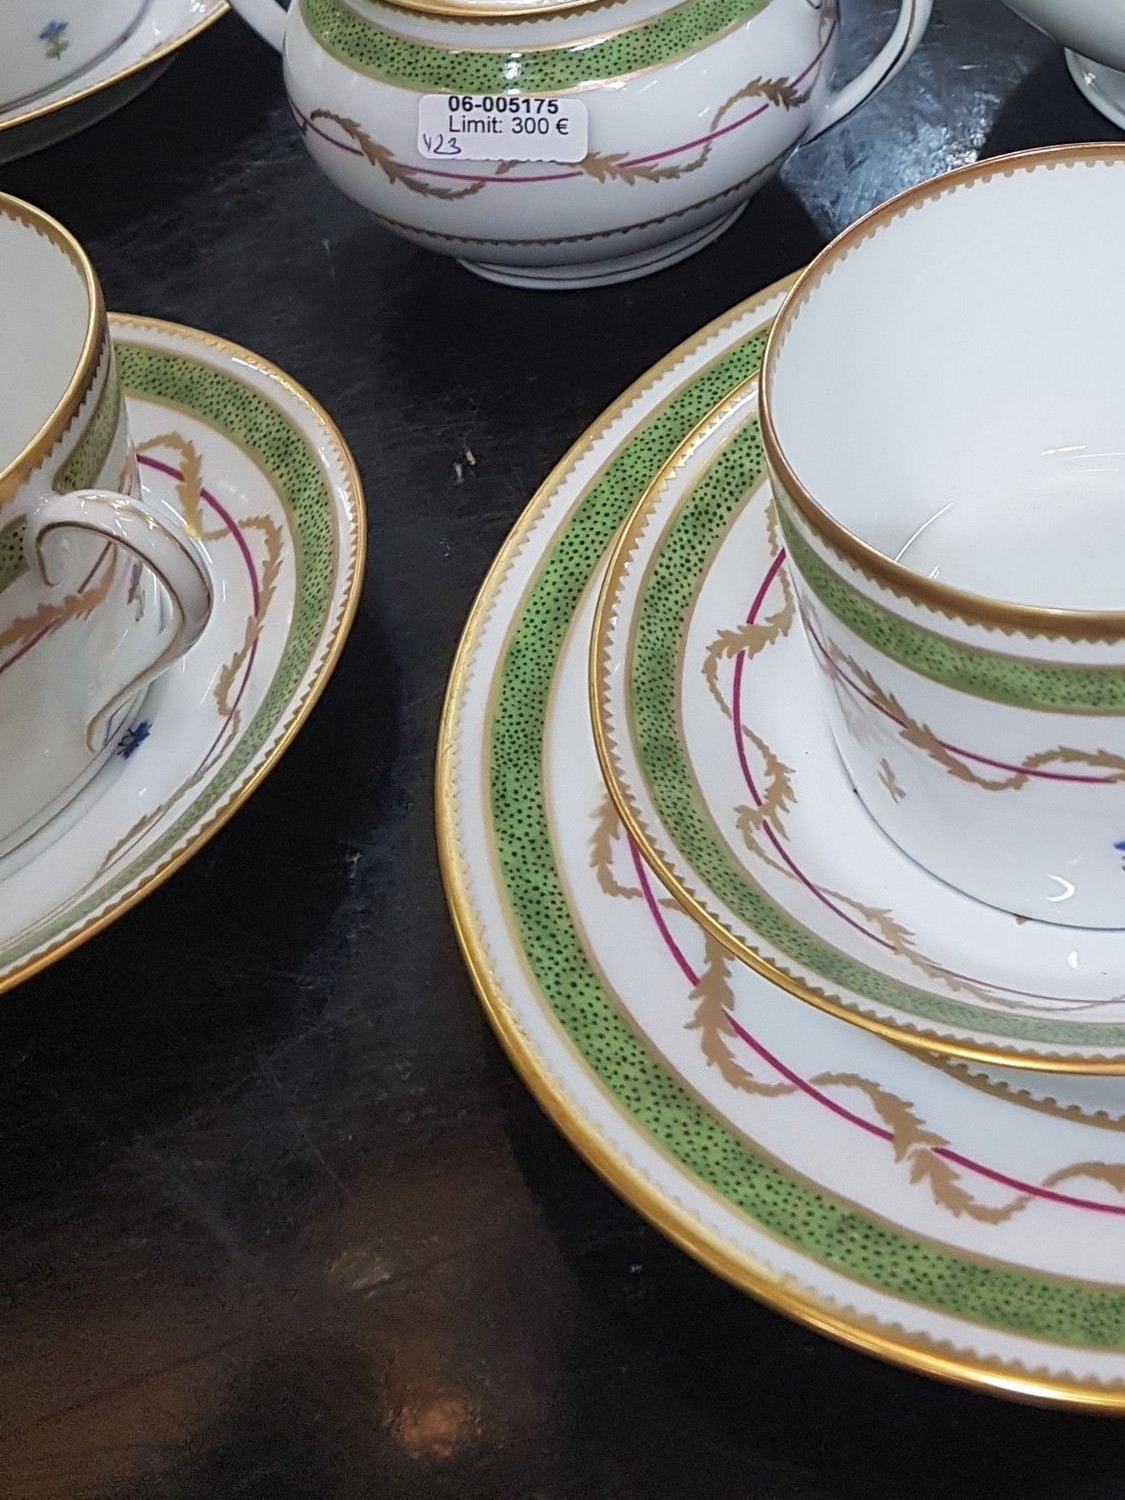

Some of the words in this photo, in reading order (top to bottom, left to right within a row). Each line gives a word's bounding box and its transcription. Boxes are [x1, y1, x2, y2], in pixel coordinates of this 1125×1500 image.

[448, 95, 559, 115] 06-005175
[449, 115, 503, 134] Limit:
[511, 116, 550, 135] 300
[555, 117, 569, 136] €
